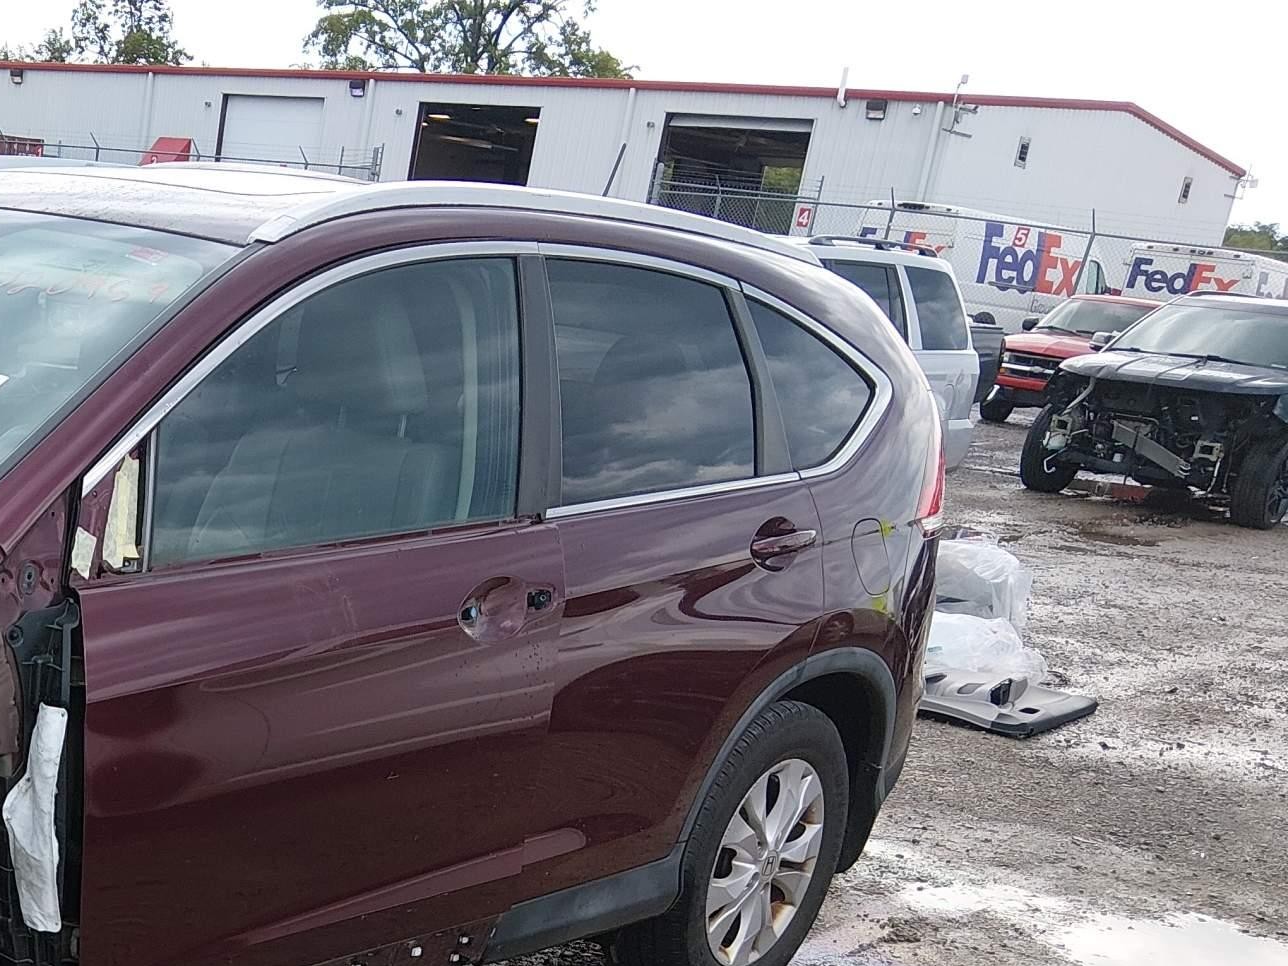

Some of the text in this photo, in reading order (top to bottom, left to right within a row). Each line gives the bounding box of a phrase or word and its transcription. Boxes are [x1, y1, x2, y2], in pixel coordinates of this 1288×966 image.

[798, 210, 810, 226] 4
[1014, 230, 1027, 248] 5
[976, 222, 1081, 298] FedEx
[1126, 256, 1240, 295] FedEx
